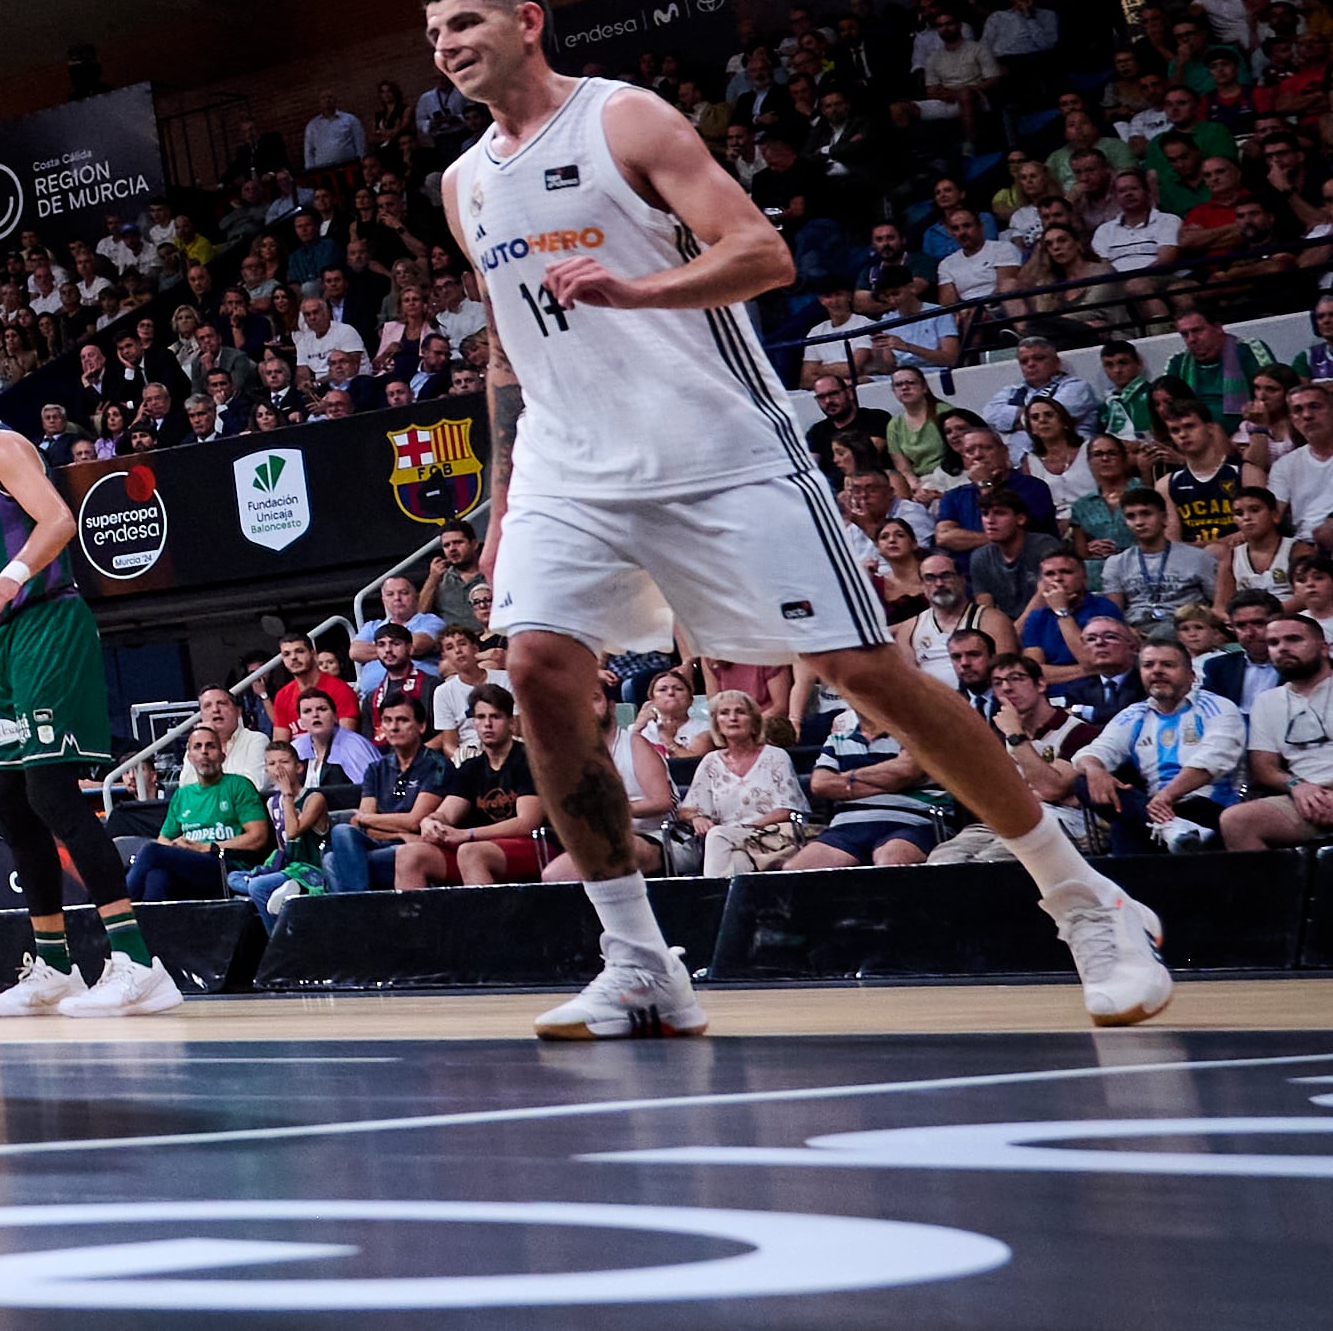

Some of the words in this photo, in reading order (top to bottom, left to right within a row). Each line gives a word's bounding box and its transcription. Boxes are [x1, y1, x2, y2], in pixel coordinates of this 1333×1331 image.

[564, 18, 638, 48] endesa
[33, 158, 60, 171] Costa
[61, 149, 92, 164] Cálida
[34, 160, 110, 197] REGIÓN
[37, 195, 64, 218] DE
[68, 174, 149, 210] MURCIA
[247, 494, 299, 512] Fundación
[86, 505, 158, 530] supercopa
[251, 519, 302, 534] Baloncesto
[256, 509, 294, 523] Unicaja
[93, 521, 160, 546] endesa
[115, 555, 141, 567] Murcia
